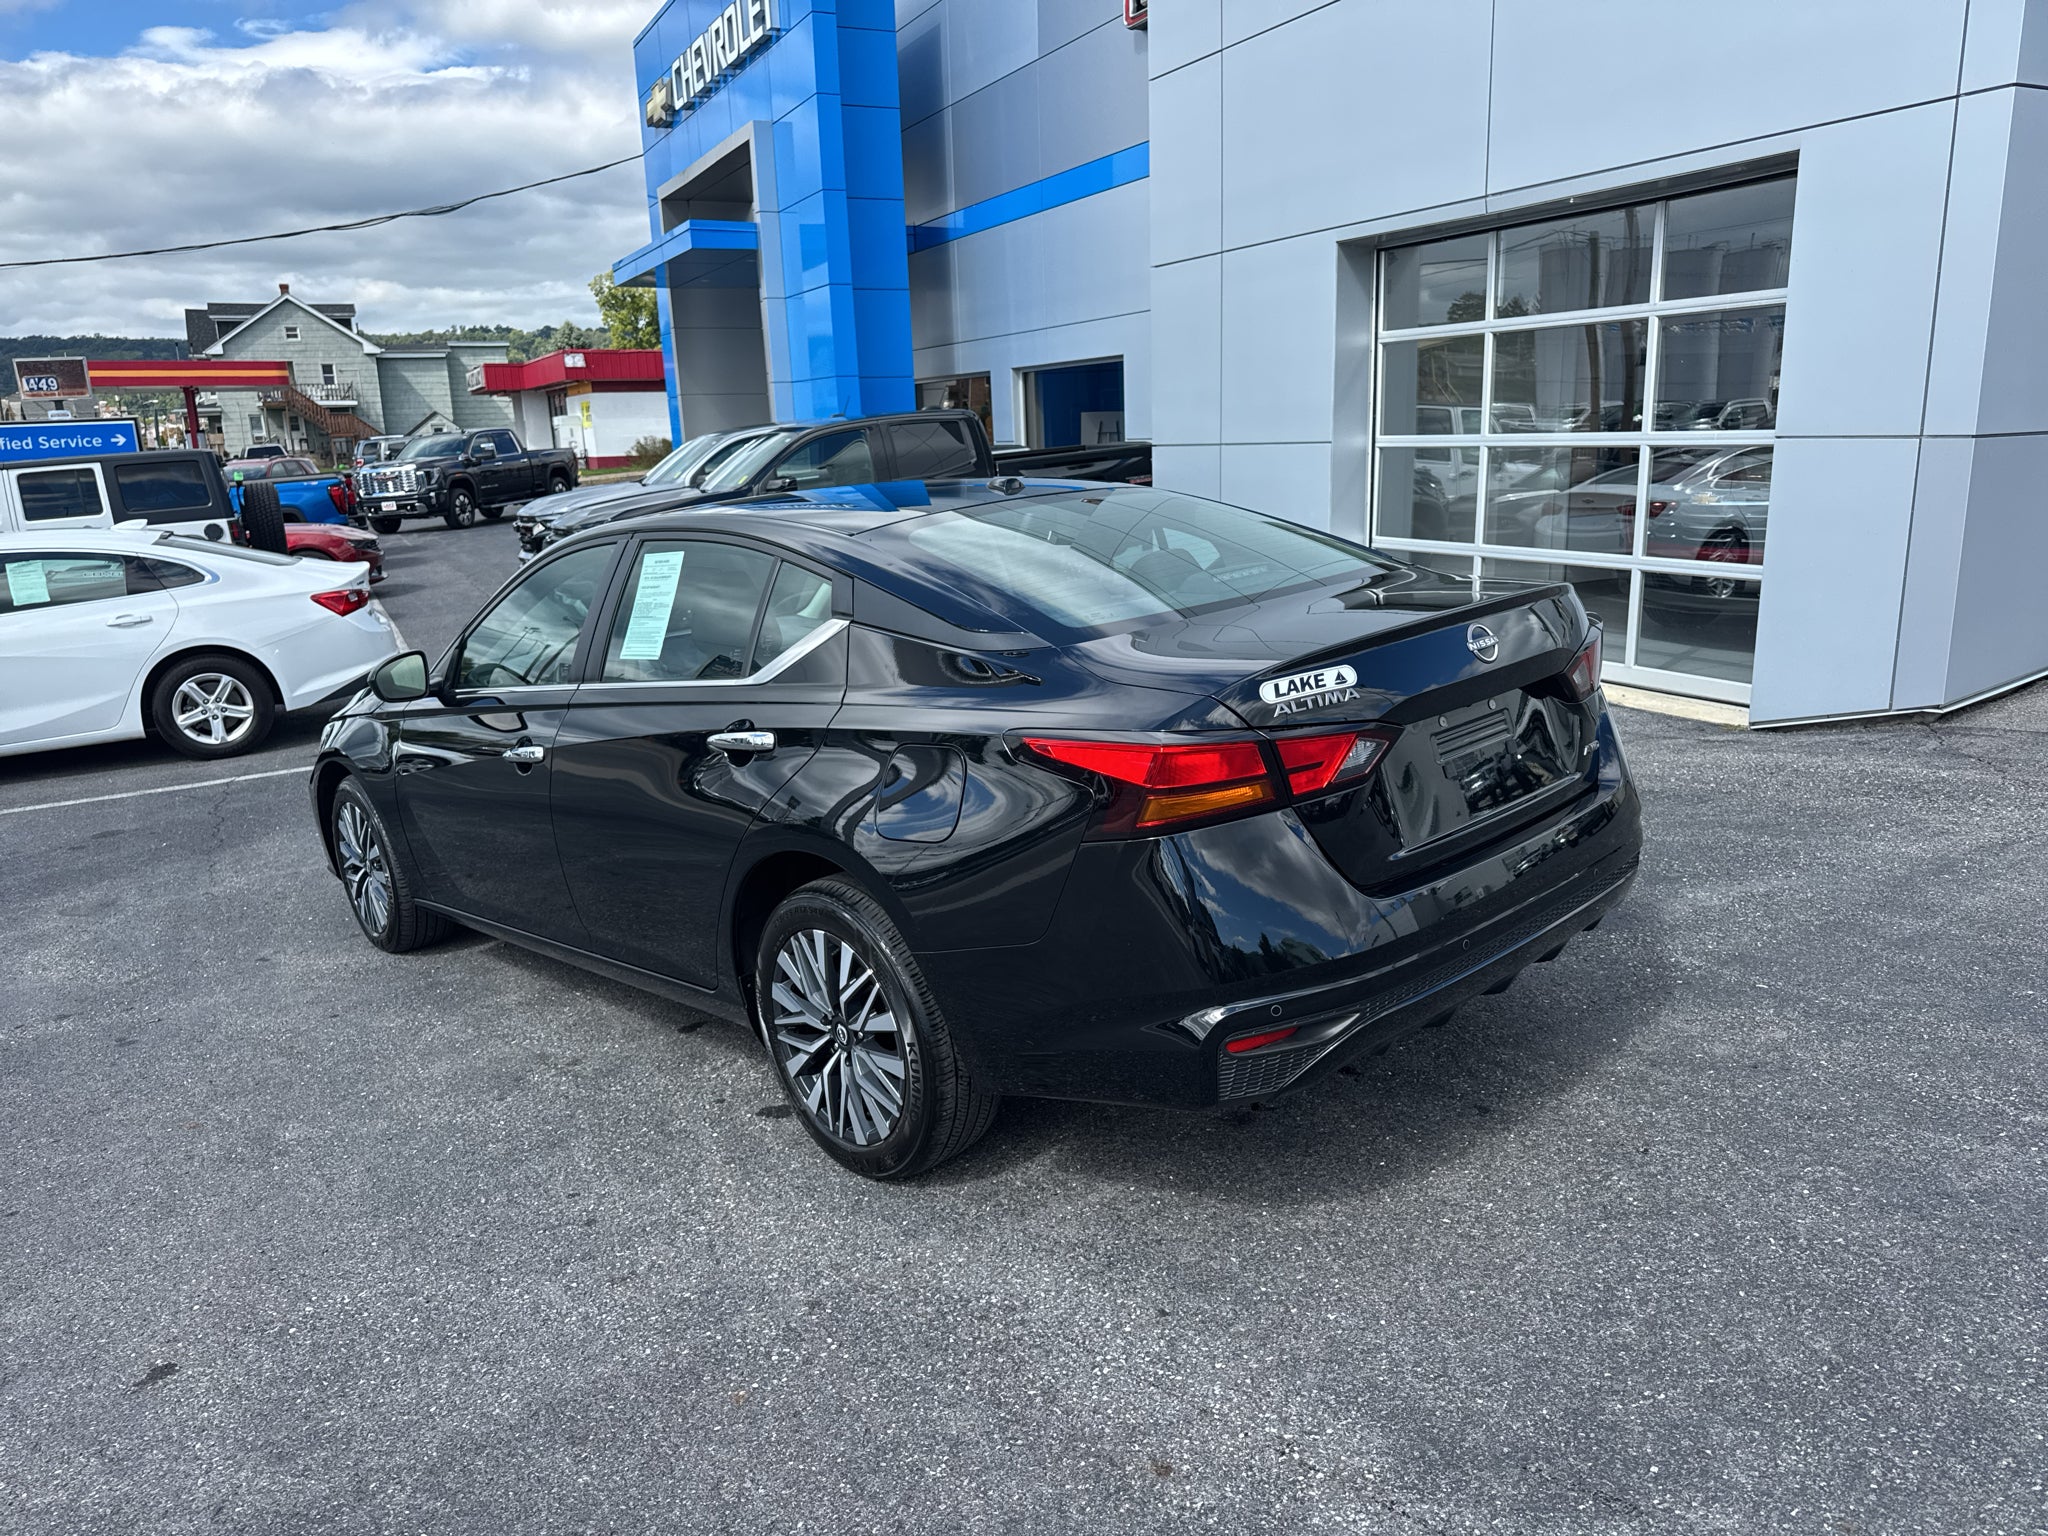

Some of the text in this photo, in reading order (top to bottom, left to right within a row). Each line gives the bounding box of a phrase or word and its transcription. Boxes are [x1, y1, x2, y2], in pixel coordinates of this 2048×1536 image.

[38, 435, 102, 449] Service
[1274, 673, 1326, 698] LAKE
[1273, 688, 1360, 717] ALTIMA
